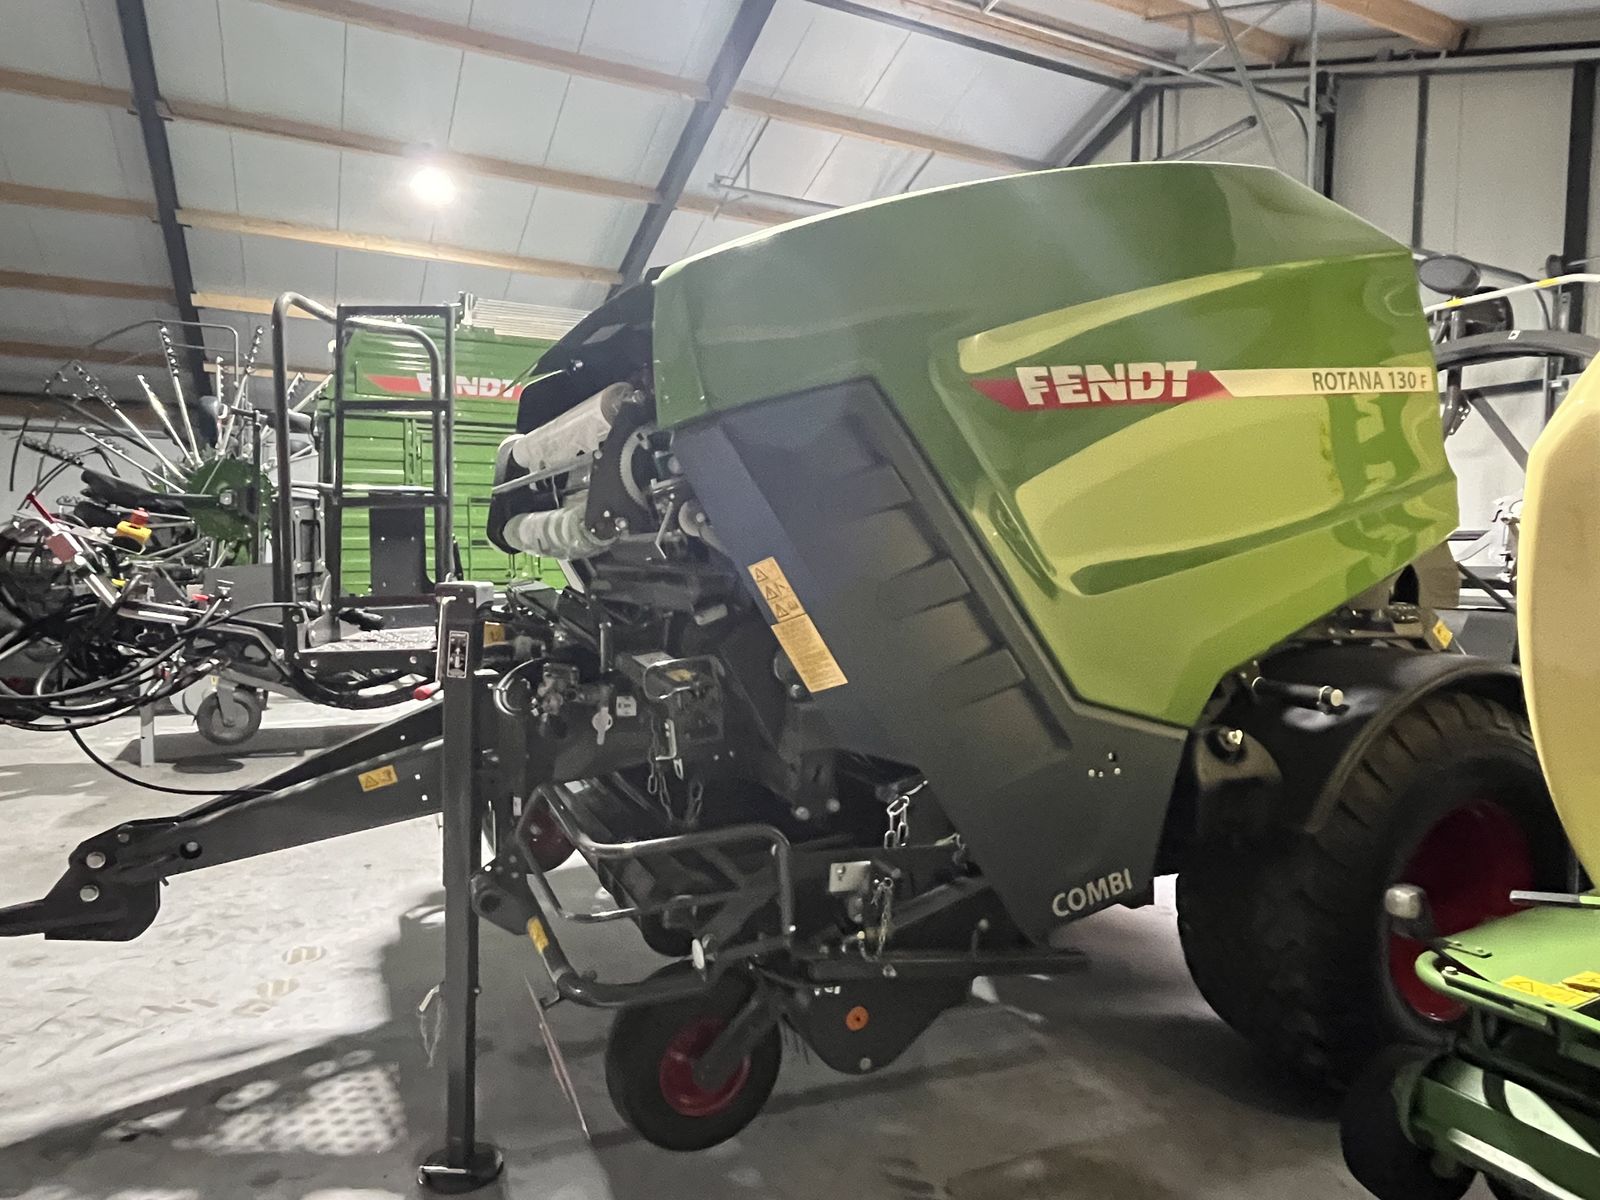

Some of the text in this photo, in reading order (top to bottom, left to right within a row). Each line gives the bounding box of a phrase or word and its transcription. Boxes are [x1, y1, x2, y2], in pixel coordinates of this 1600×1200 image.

[1015, 361, 1197, 406] FENDT
[1312, 371, 1427, 391] ROTANA 130 F
[1052, 868, 1133, 917] COMBI
